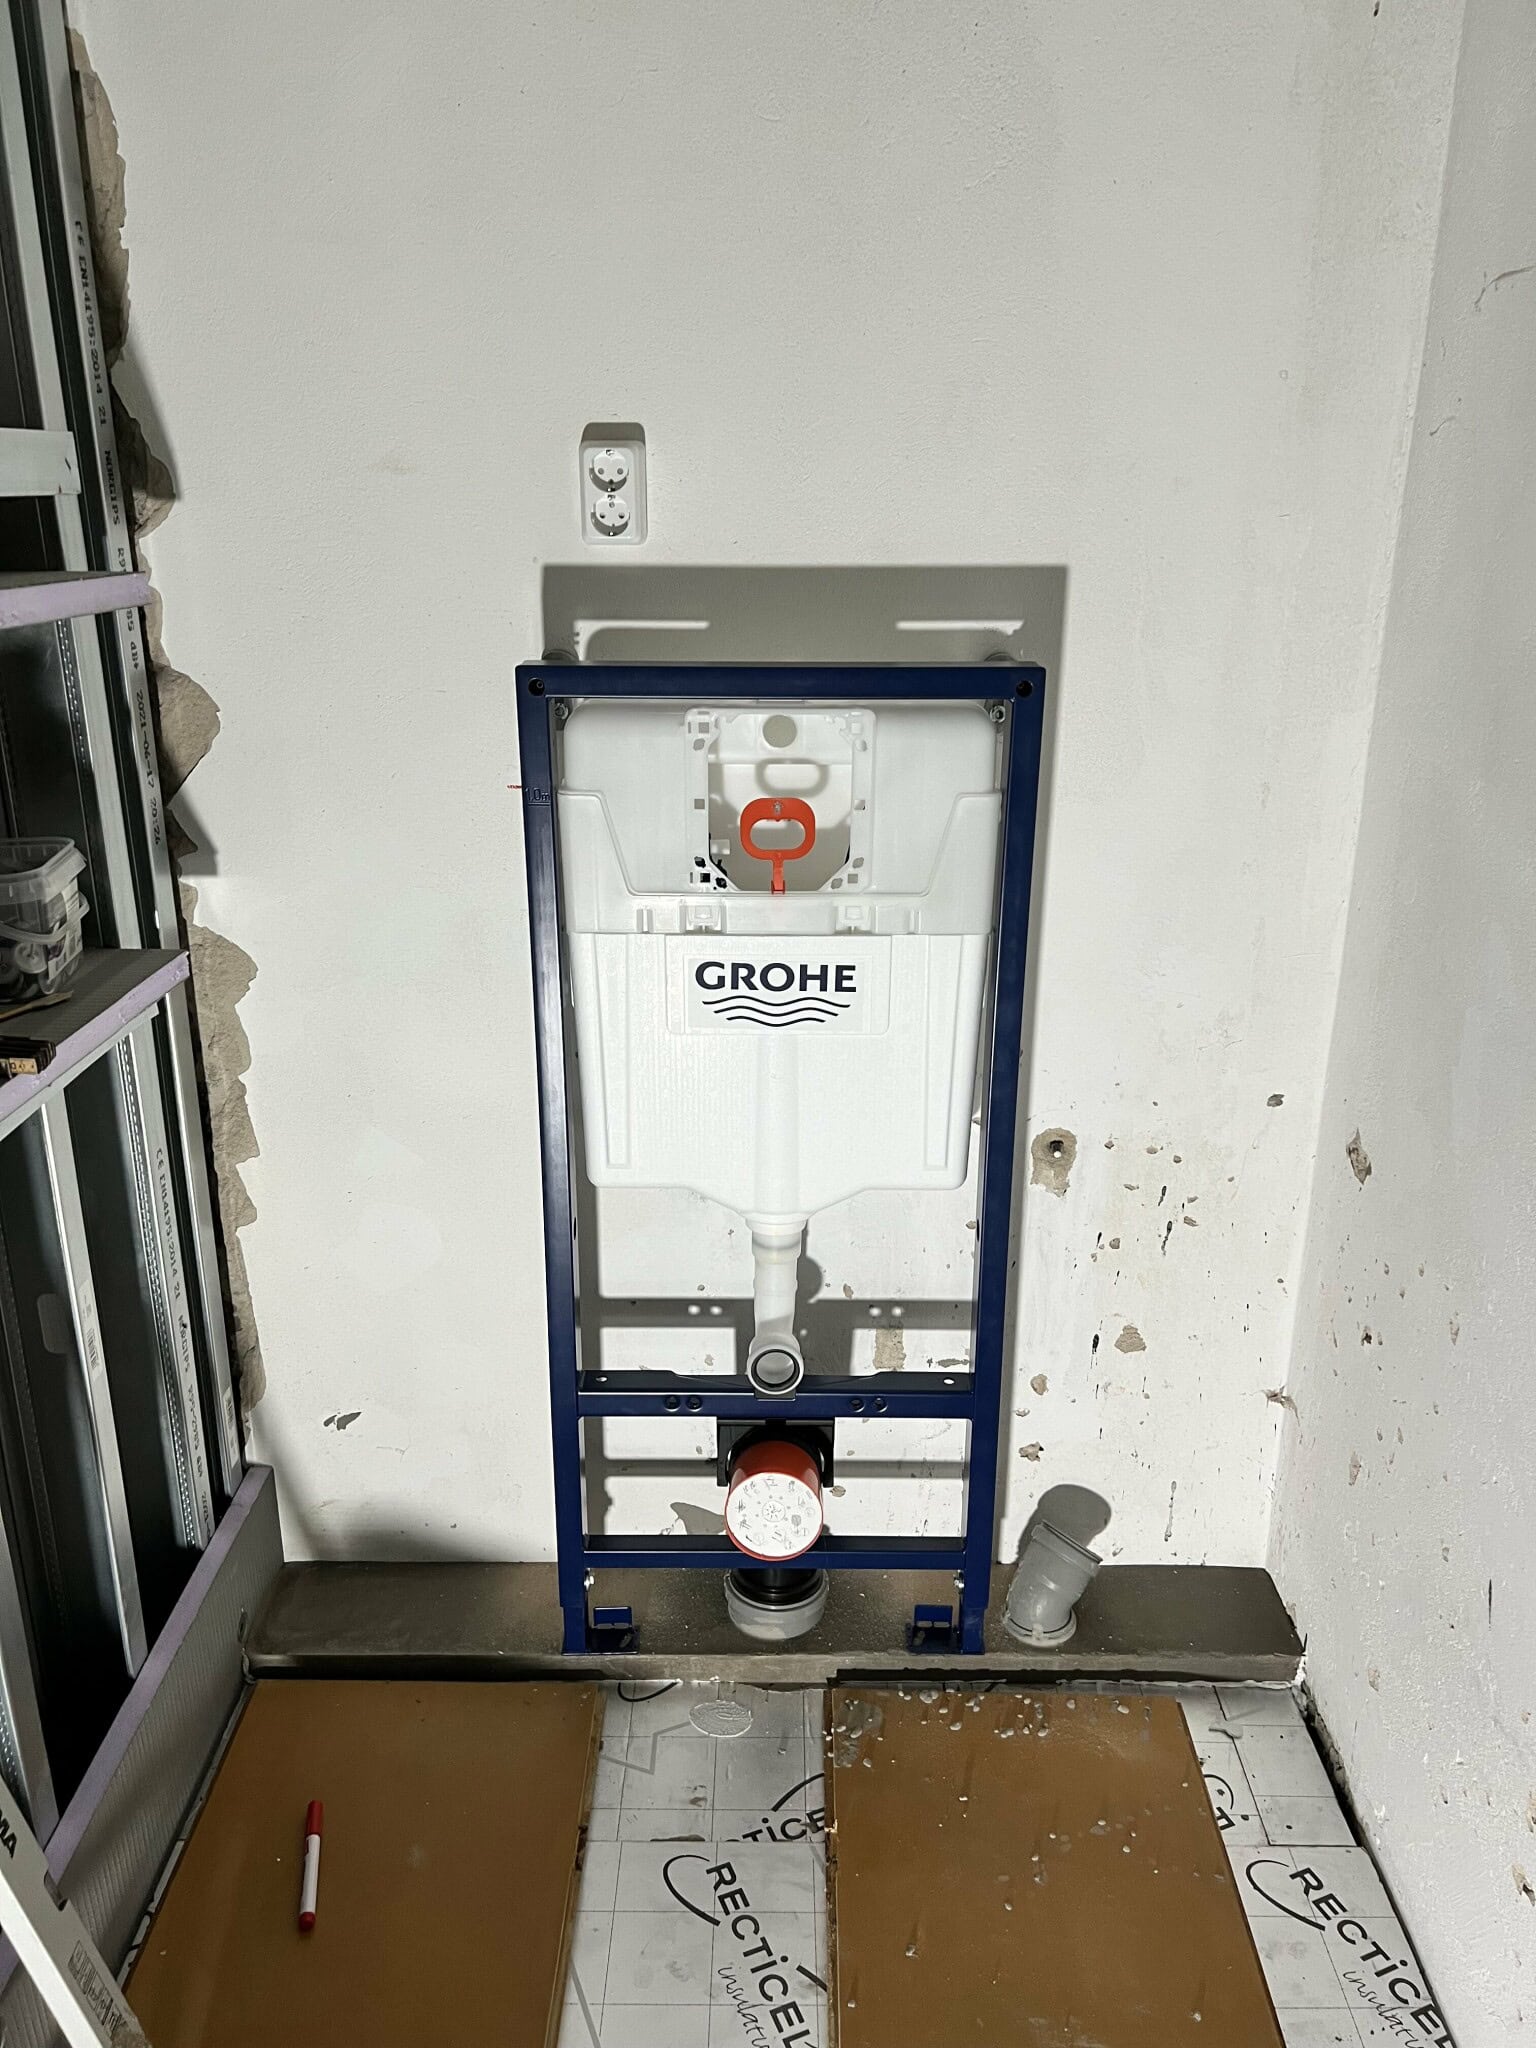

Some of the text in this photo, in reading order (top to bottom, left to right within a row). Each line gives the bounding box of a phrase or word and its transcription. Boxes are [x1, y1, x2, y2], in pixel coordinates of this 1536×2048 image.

[105, 450, 120, 525] NORGIPS
[137, 689, 154, 788] 2021-06-17
[150, 797, 160, 844] 20:26
[695, 961, 857, 993] GROHE
[160, 1173, 177, 1277] EN14195:2014
[174, 1281, 181, 1299] 21
